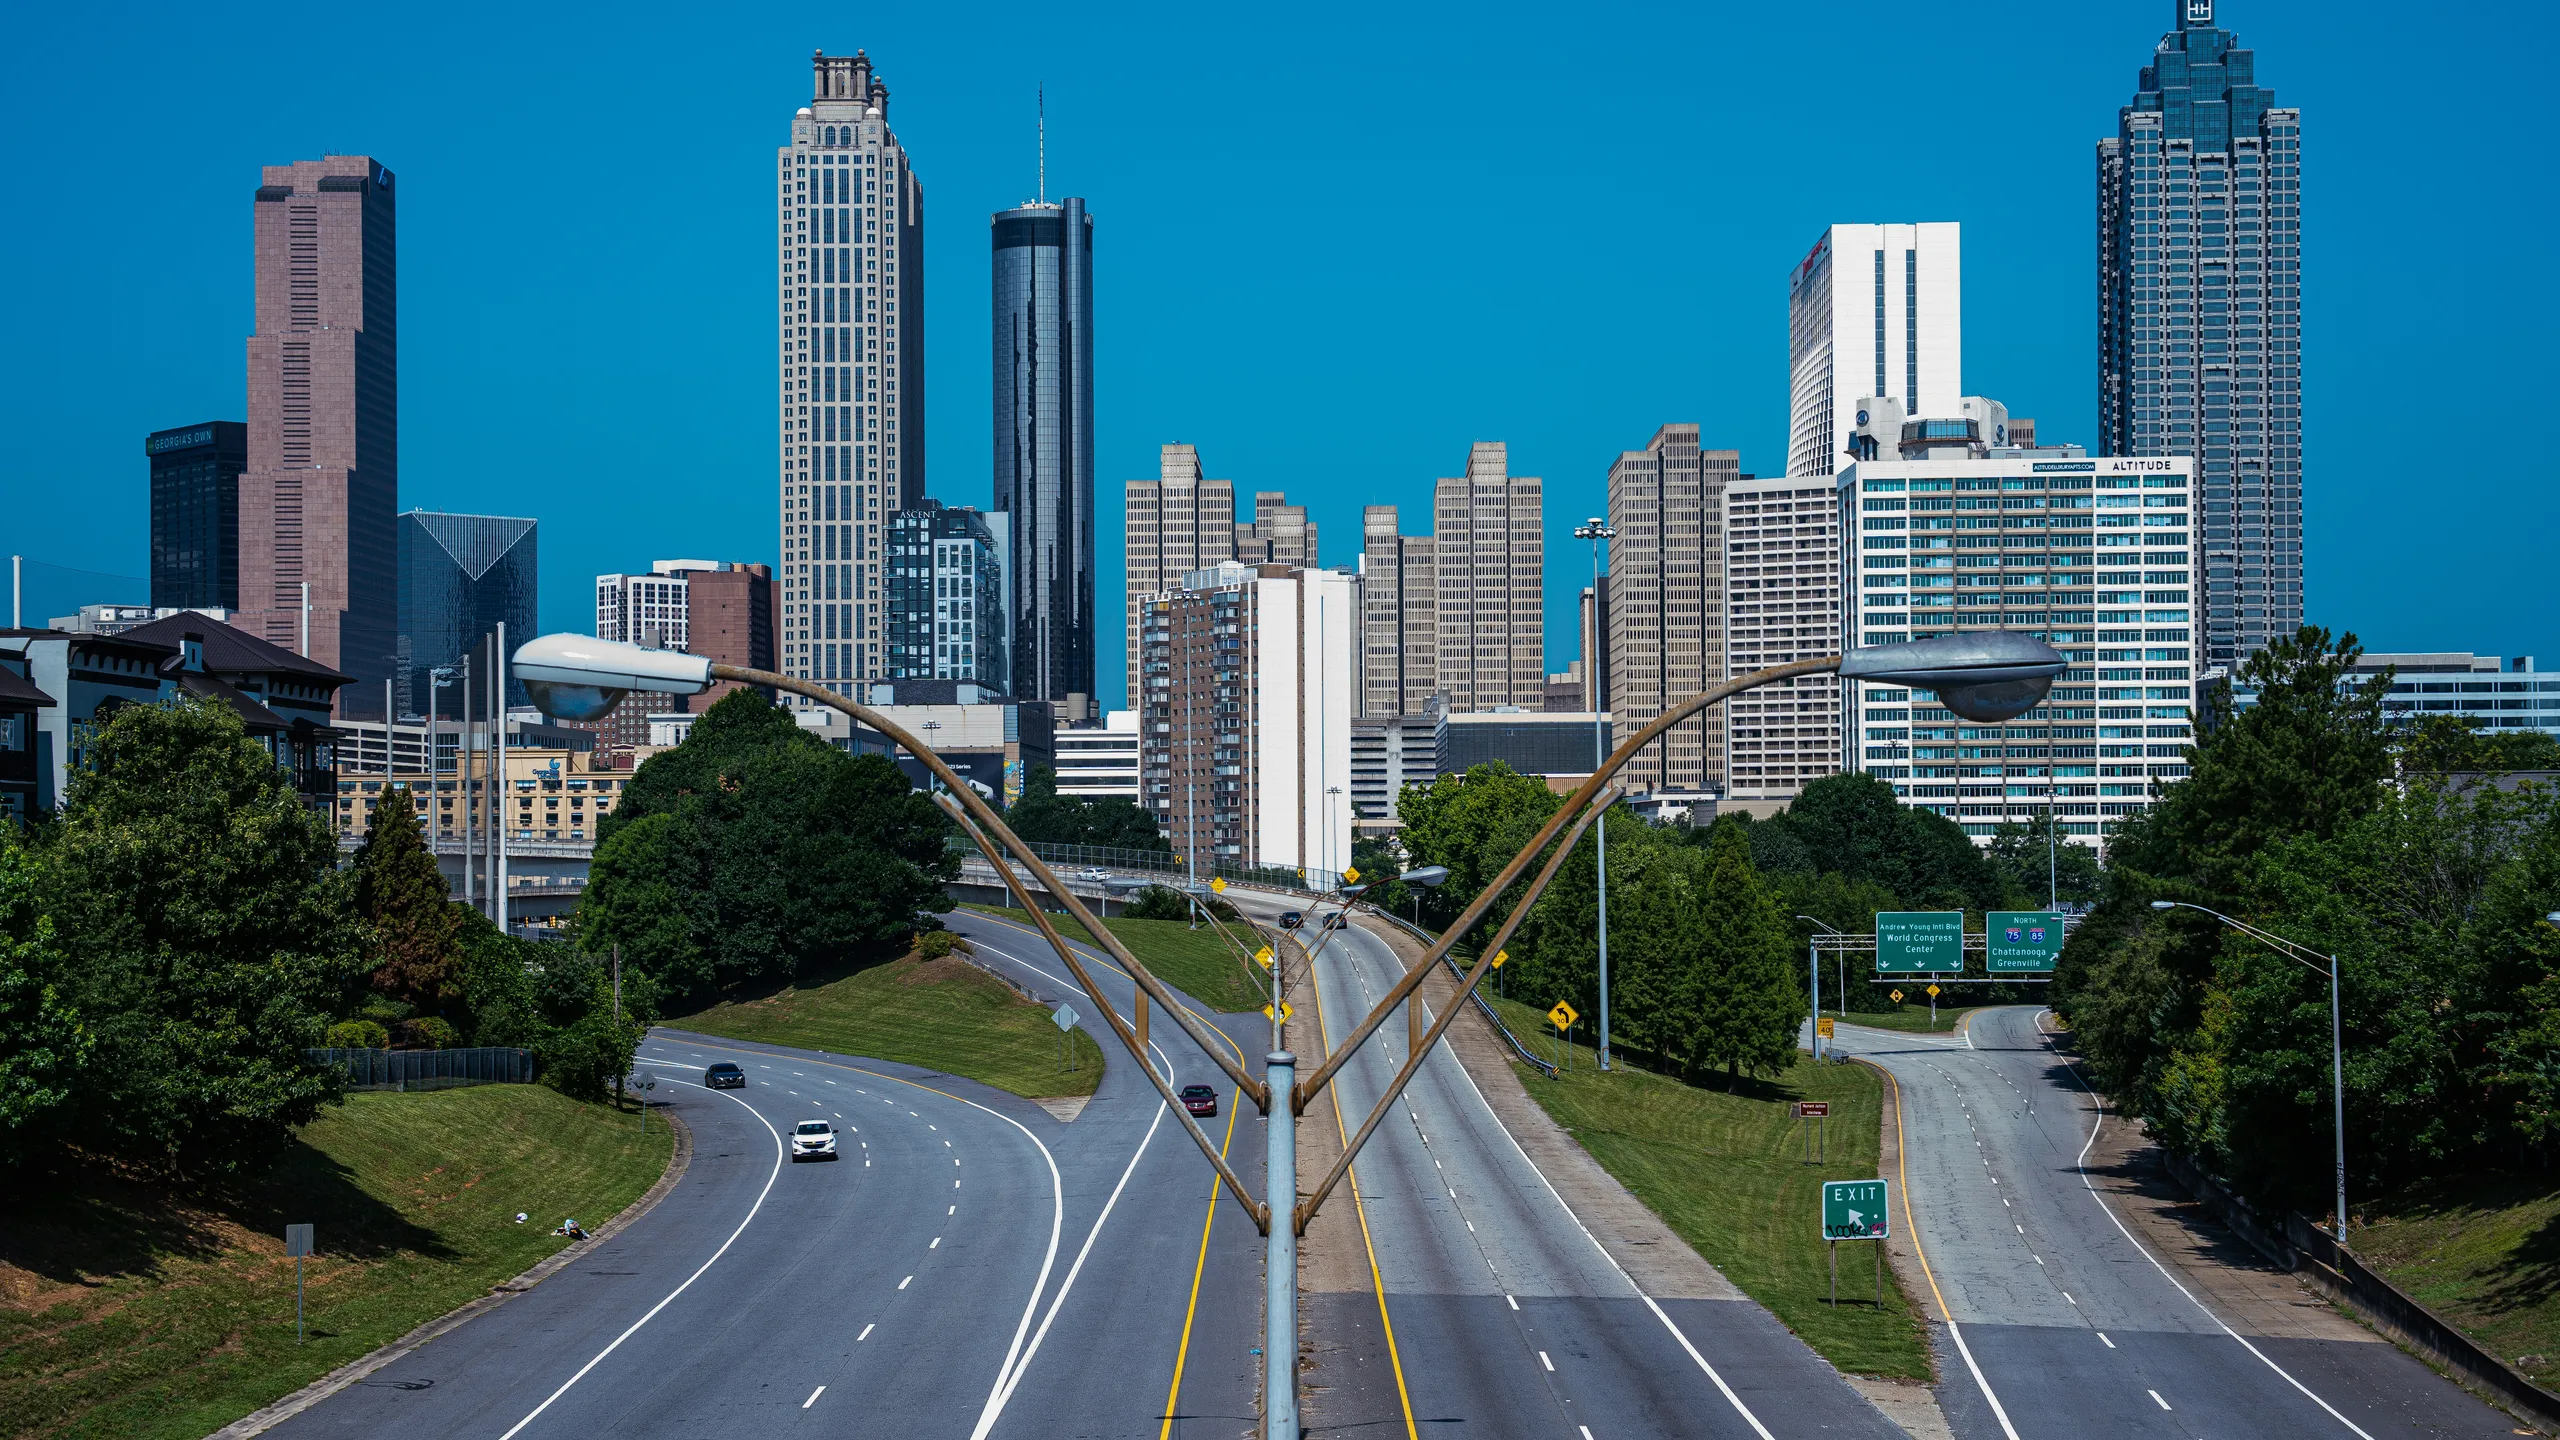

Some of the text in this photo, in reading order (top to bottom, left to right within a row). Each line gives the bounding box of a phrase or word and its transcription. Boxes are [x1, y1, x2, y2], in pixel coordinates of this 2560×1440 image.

[155, 434, 192, 449] GEORGIA'S
[194, 430, 212, 442] OWN
[2112, 460, 2171, 471] ALTITUDE
[900, 510, 937, 519] ASCENT
[1880, 923, 1906, 931] Andrew
[1909, 923, 1931, 932] Young
[1886, 934, 1953, 944] World Congress
[2008, 931, 2019, 940] 75
[2031, 932, 2043, 940] 85
[1905, 945, 1934, 953] Center
[1992, 947, 2046, 958] Chattanooga
[1997, 958, 2041, 967] Greenville
[1834, 1186, 1876, 1201] EXIT
